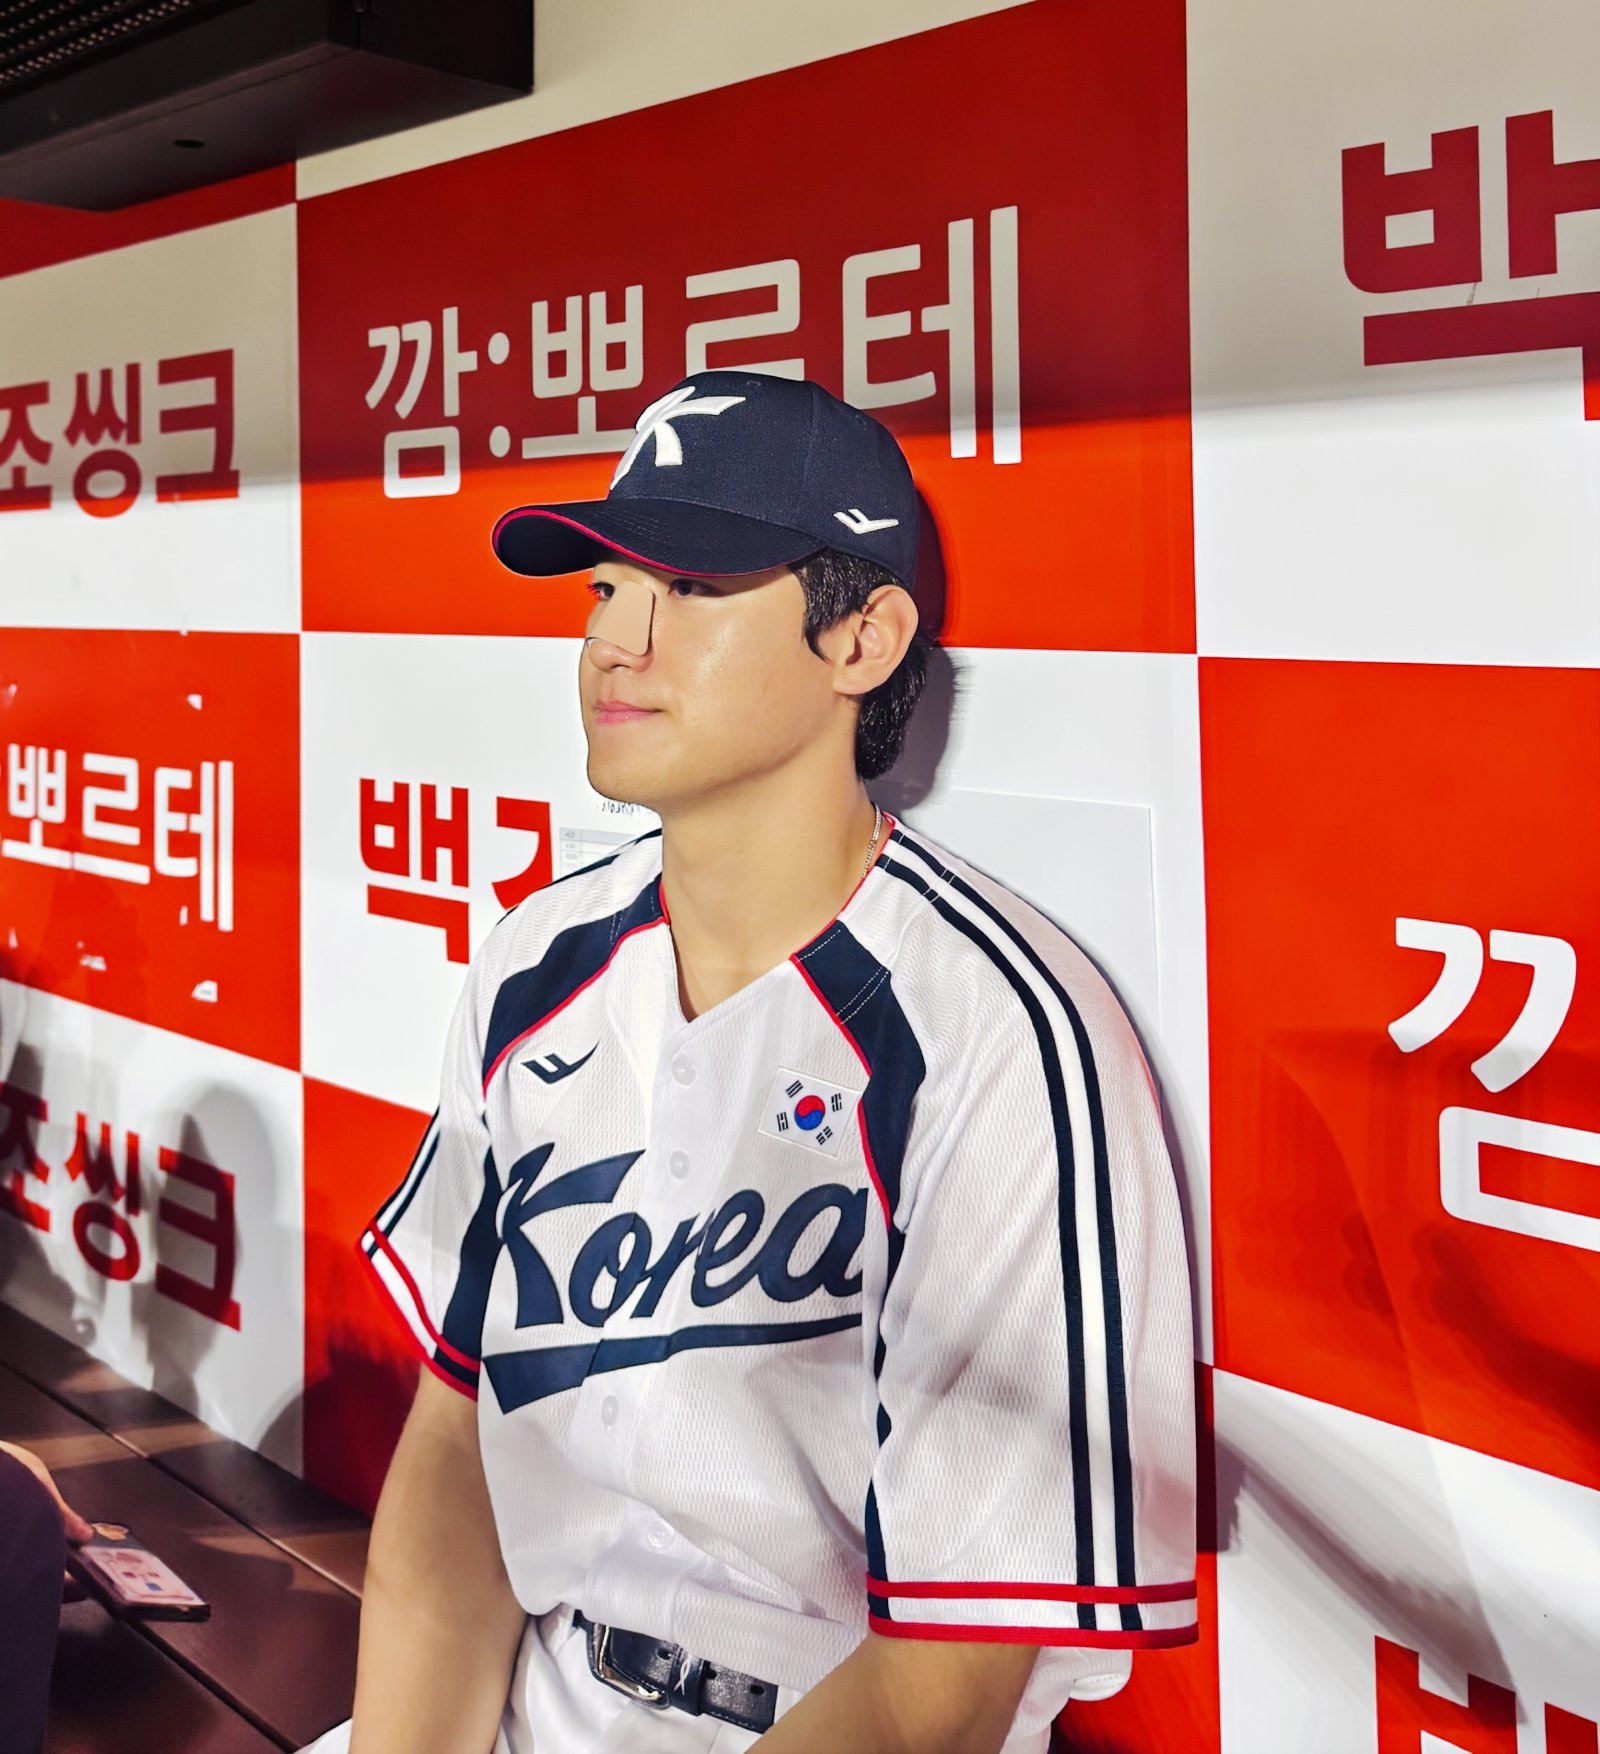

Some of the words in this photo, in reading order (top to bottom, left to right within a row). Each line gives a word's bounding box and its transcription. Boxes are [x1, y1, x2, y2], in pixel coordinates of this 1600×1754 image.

[0, 348, 240, 518] 조씽크
[365, 205, 1022, 499] 깜:뽀르테
[0, 1081, 241, 1332] 조씽크
[500, 1142, 869, 1330] Korea
